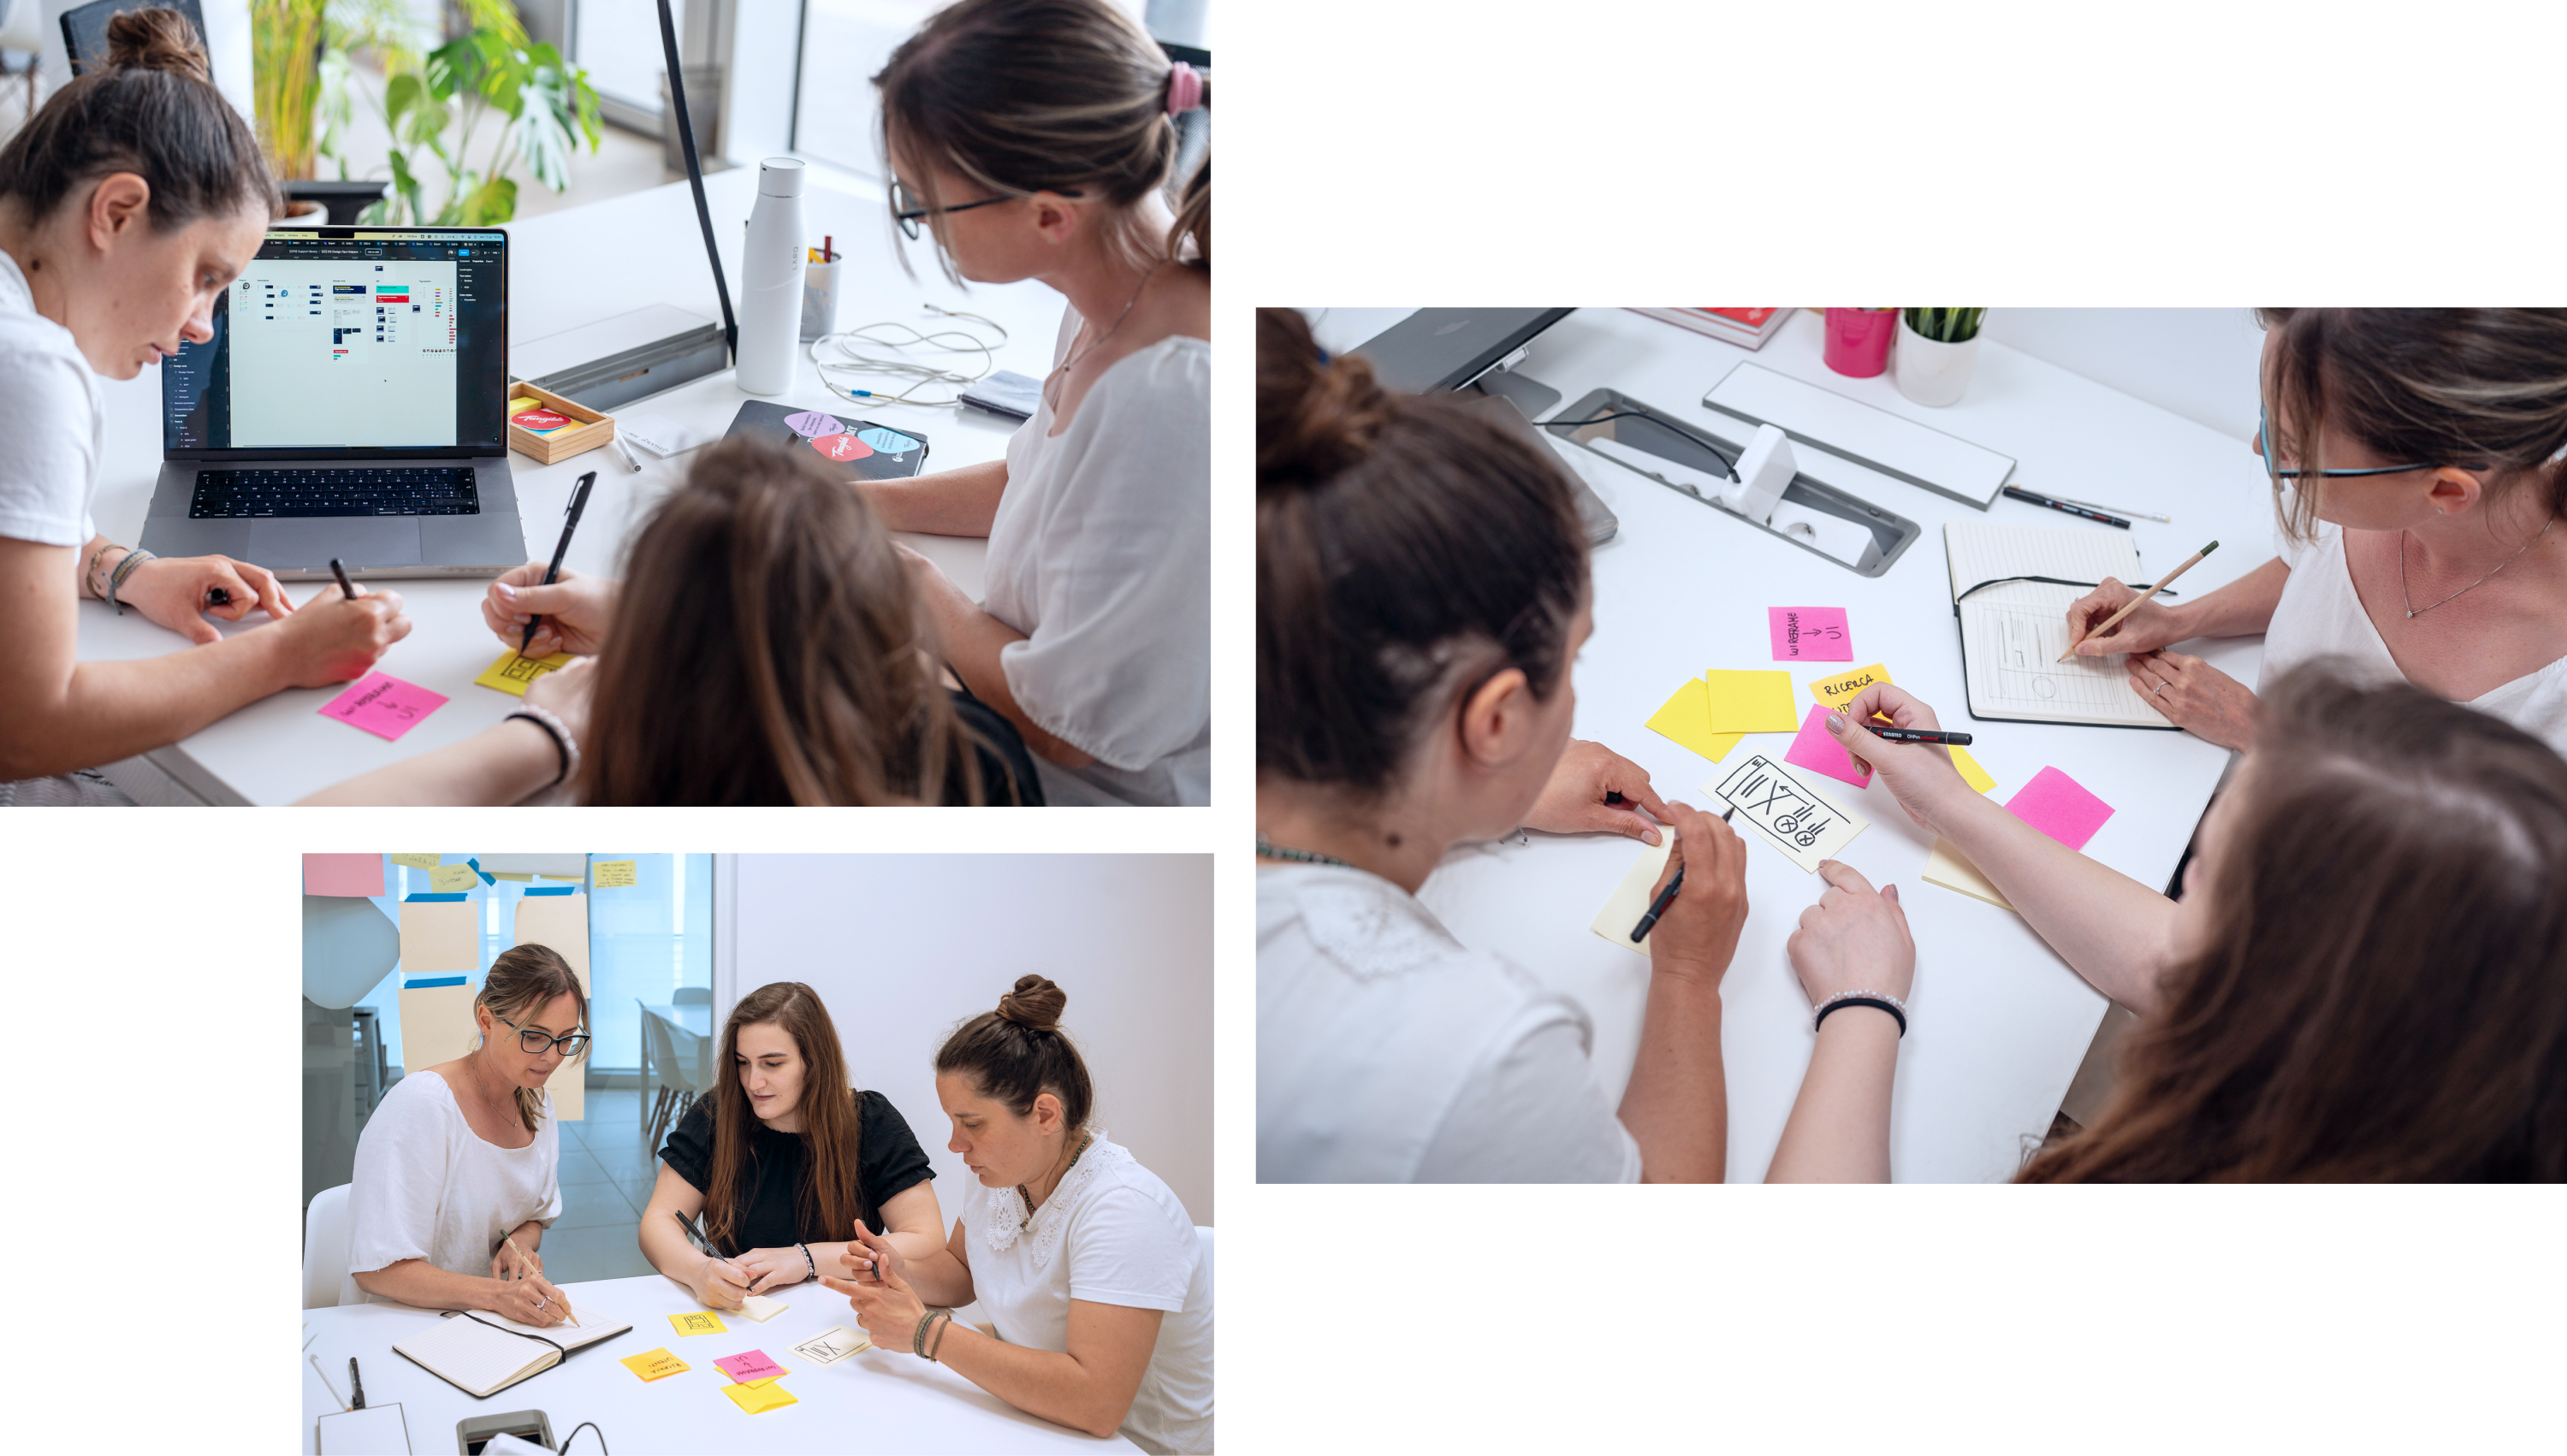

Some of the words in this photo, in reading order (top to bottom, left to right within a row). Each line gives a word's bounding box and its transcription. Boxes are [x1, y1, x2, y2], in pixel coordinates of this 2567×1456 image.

[518, 415, 564, 424] Tangible
[832, 436, 852, 457] Tangible
[1787, 612, 1799, 656] WIREFRAME
[1826, 626, 1842, 639] UI
